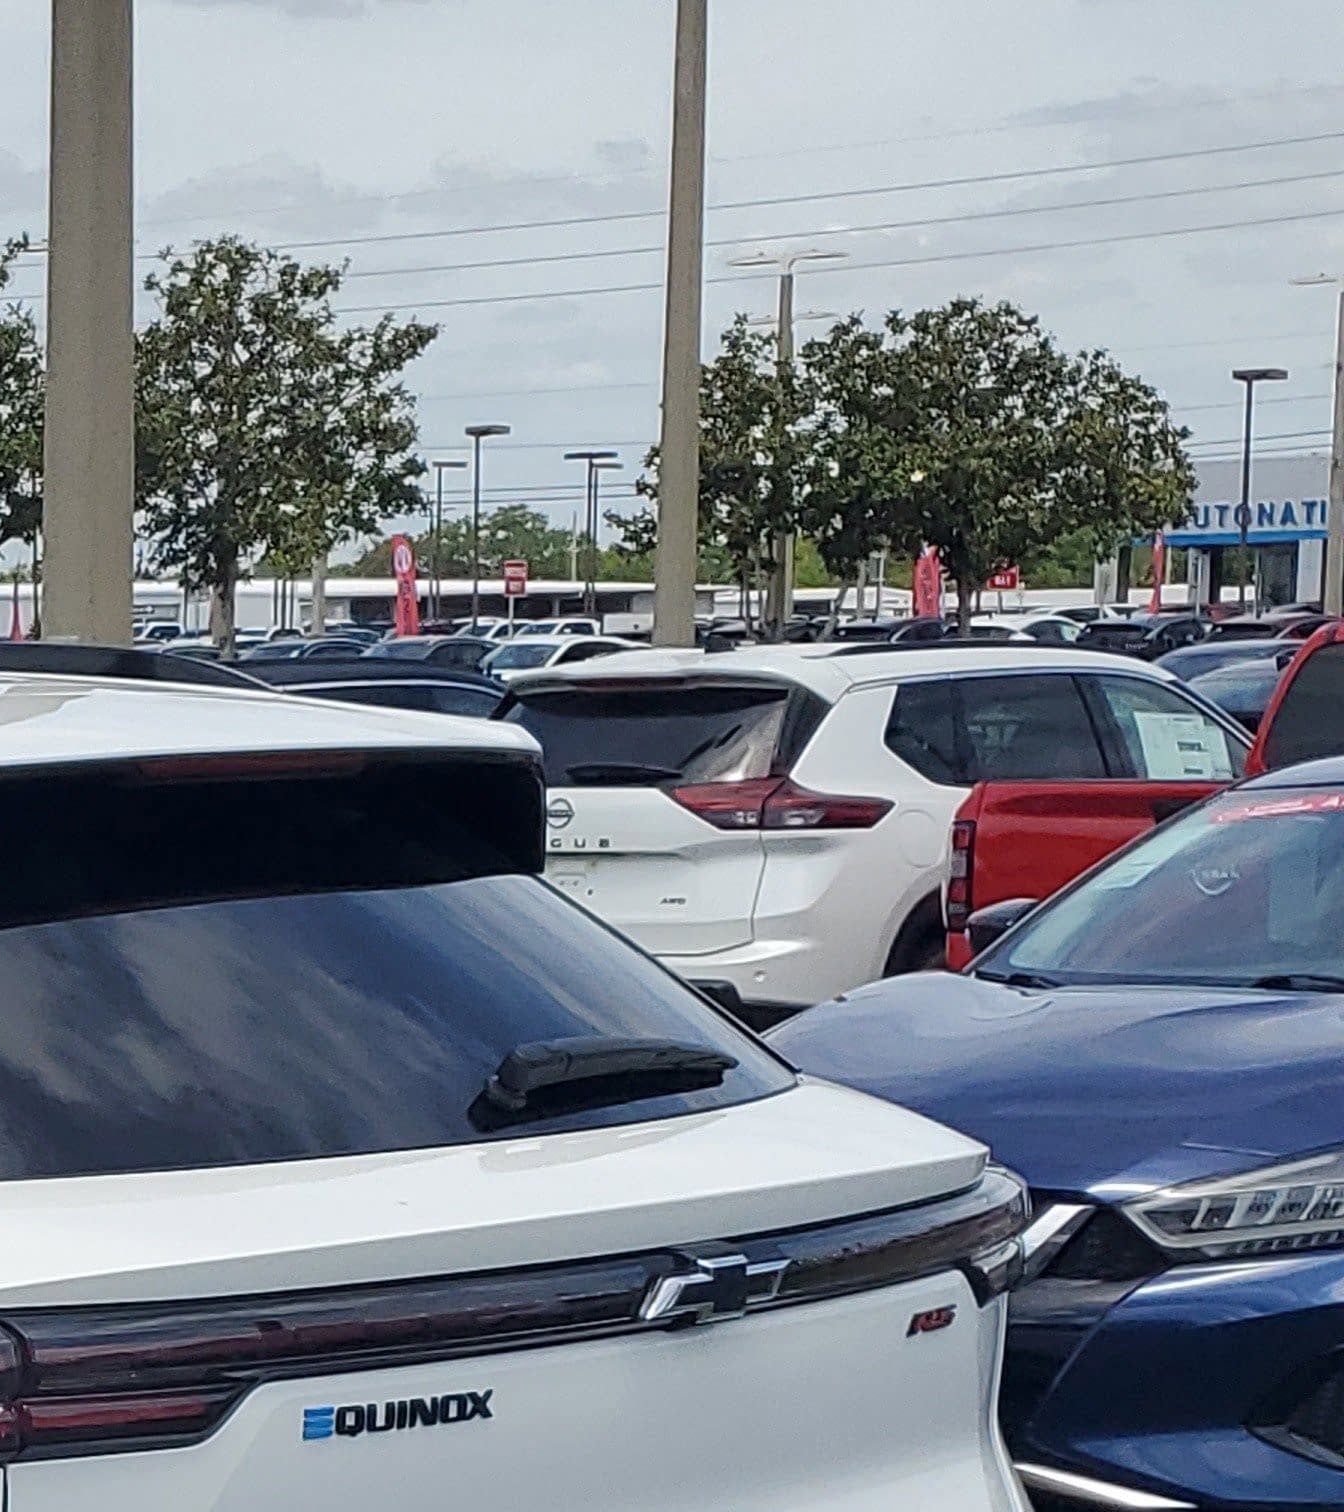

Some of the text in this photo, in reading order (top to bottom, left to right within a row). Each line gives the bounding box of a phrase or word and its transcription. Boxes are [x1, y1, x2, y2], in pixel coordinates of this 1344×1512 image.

[1193, 499, 1327, 529] UTONATI
[550, 838, 610, 849] GUE
[906, 1304, 957, 1338] RS
[302, 1389, 494, 1441] EQUINOX
